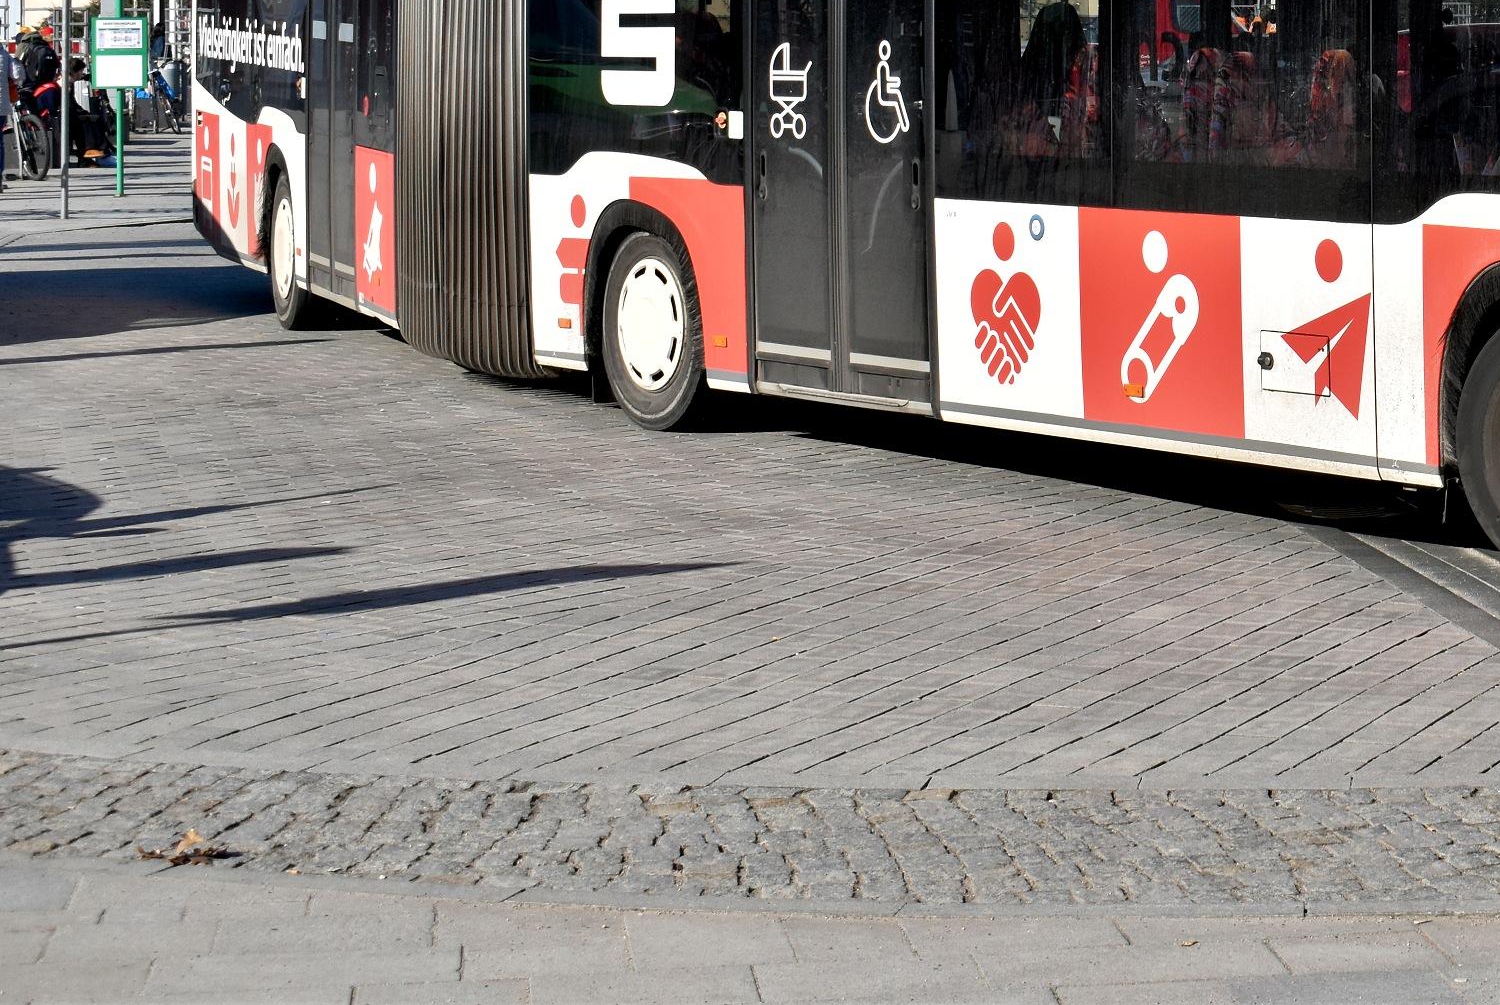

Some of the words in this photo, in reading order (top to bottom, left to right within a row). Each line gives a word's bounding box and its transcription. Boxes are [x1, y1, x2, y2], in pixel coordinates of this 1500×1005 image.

[199, 15, 253, 74] Vielseitigkeit
[253, 19, 266, 67] ist
[266, 21, 305, 74] einfach.
